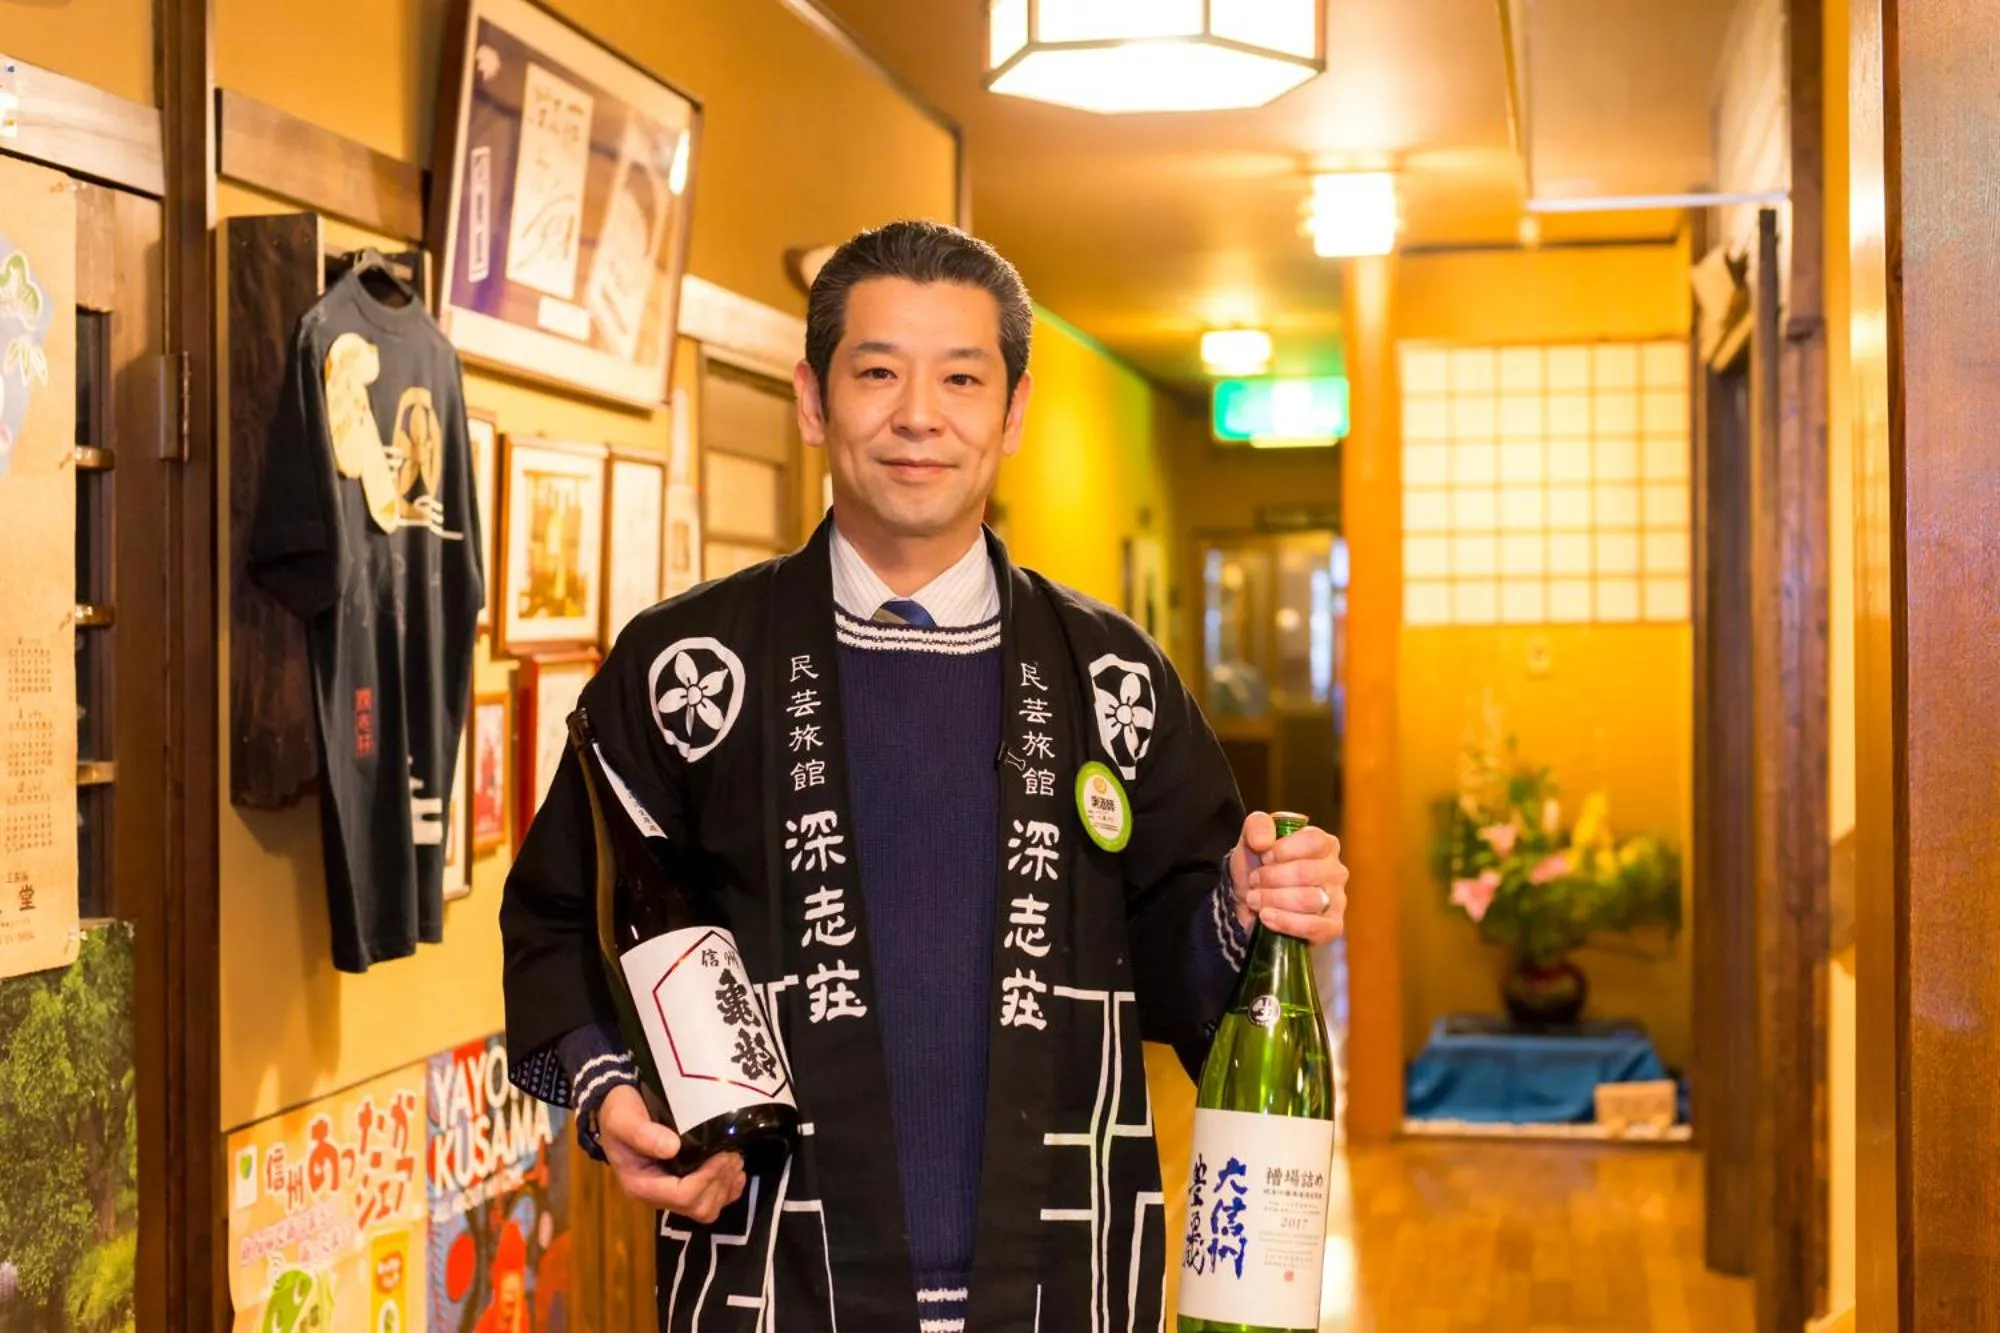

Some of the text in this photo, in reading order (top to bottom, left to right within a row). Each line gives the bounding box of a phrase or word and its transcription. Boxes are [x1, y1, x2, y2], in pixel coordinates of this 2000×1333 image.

[785, 654, 826, 792] 民芸旅館
[1018, 661, 1056, 797] 民芸旅館
[700, 948, 740, 969] 信州
[784, 809, 868, 1024] 深志荘
[1000, 819, 1061, 1031] 深志荘
[434, 1098, 554, 1198] KUSAMA
[1206, 1155, 1250, 1281] 大信州
[1280, 1216, 1309, 1231] 2017
